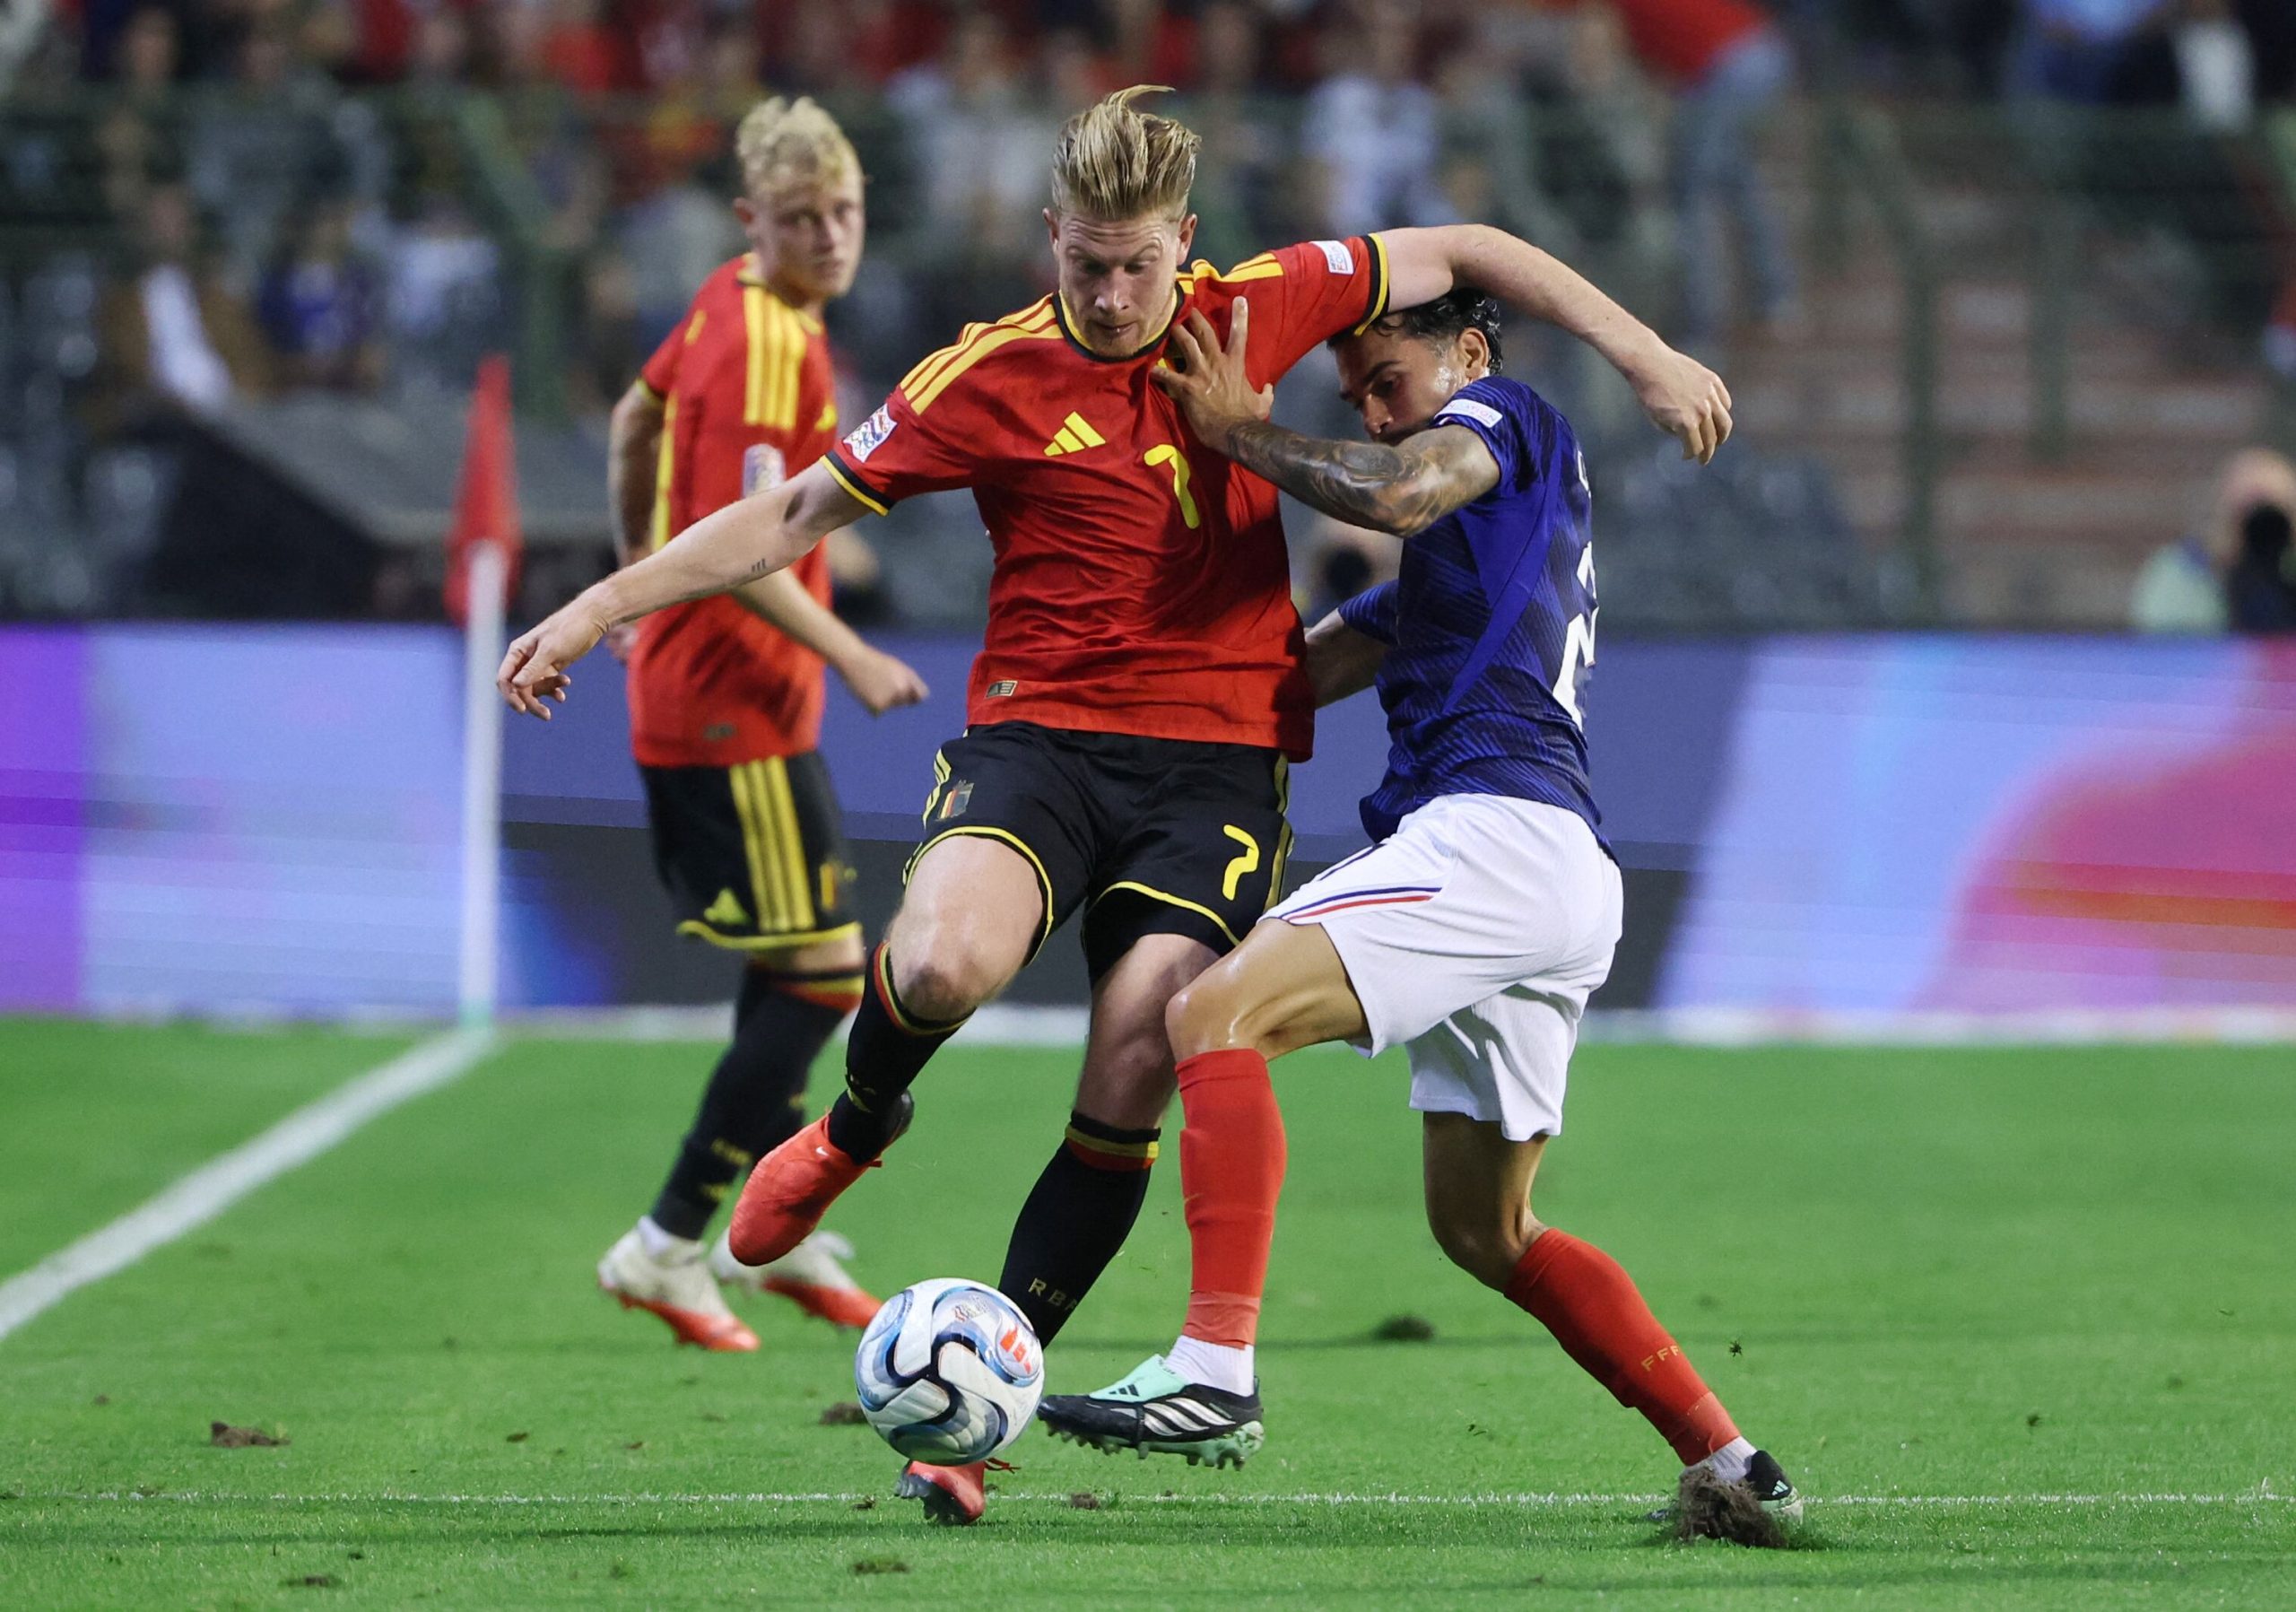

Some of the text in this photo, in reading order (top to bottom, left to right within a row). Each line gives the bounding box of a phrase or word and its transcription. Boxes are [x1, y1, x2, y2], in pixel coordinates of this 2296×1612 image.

[1144, 443, 1200, 529] 7
[1222, 824, 1260, 902] 7
[1641, 1345, 1679, 1372] FFF
